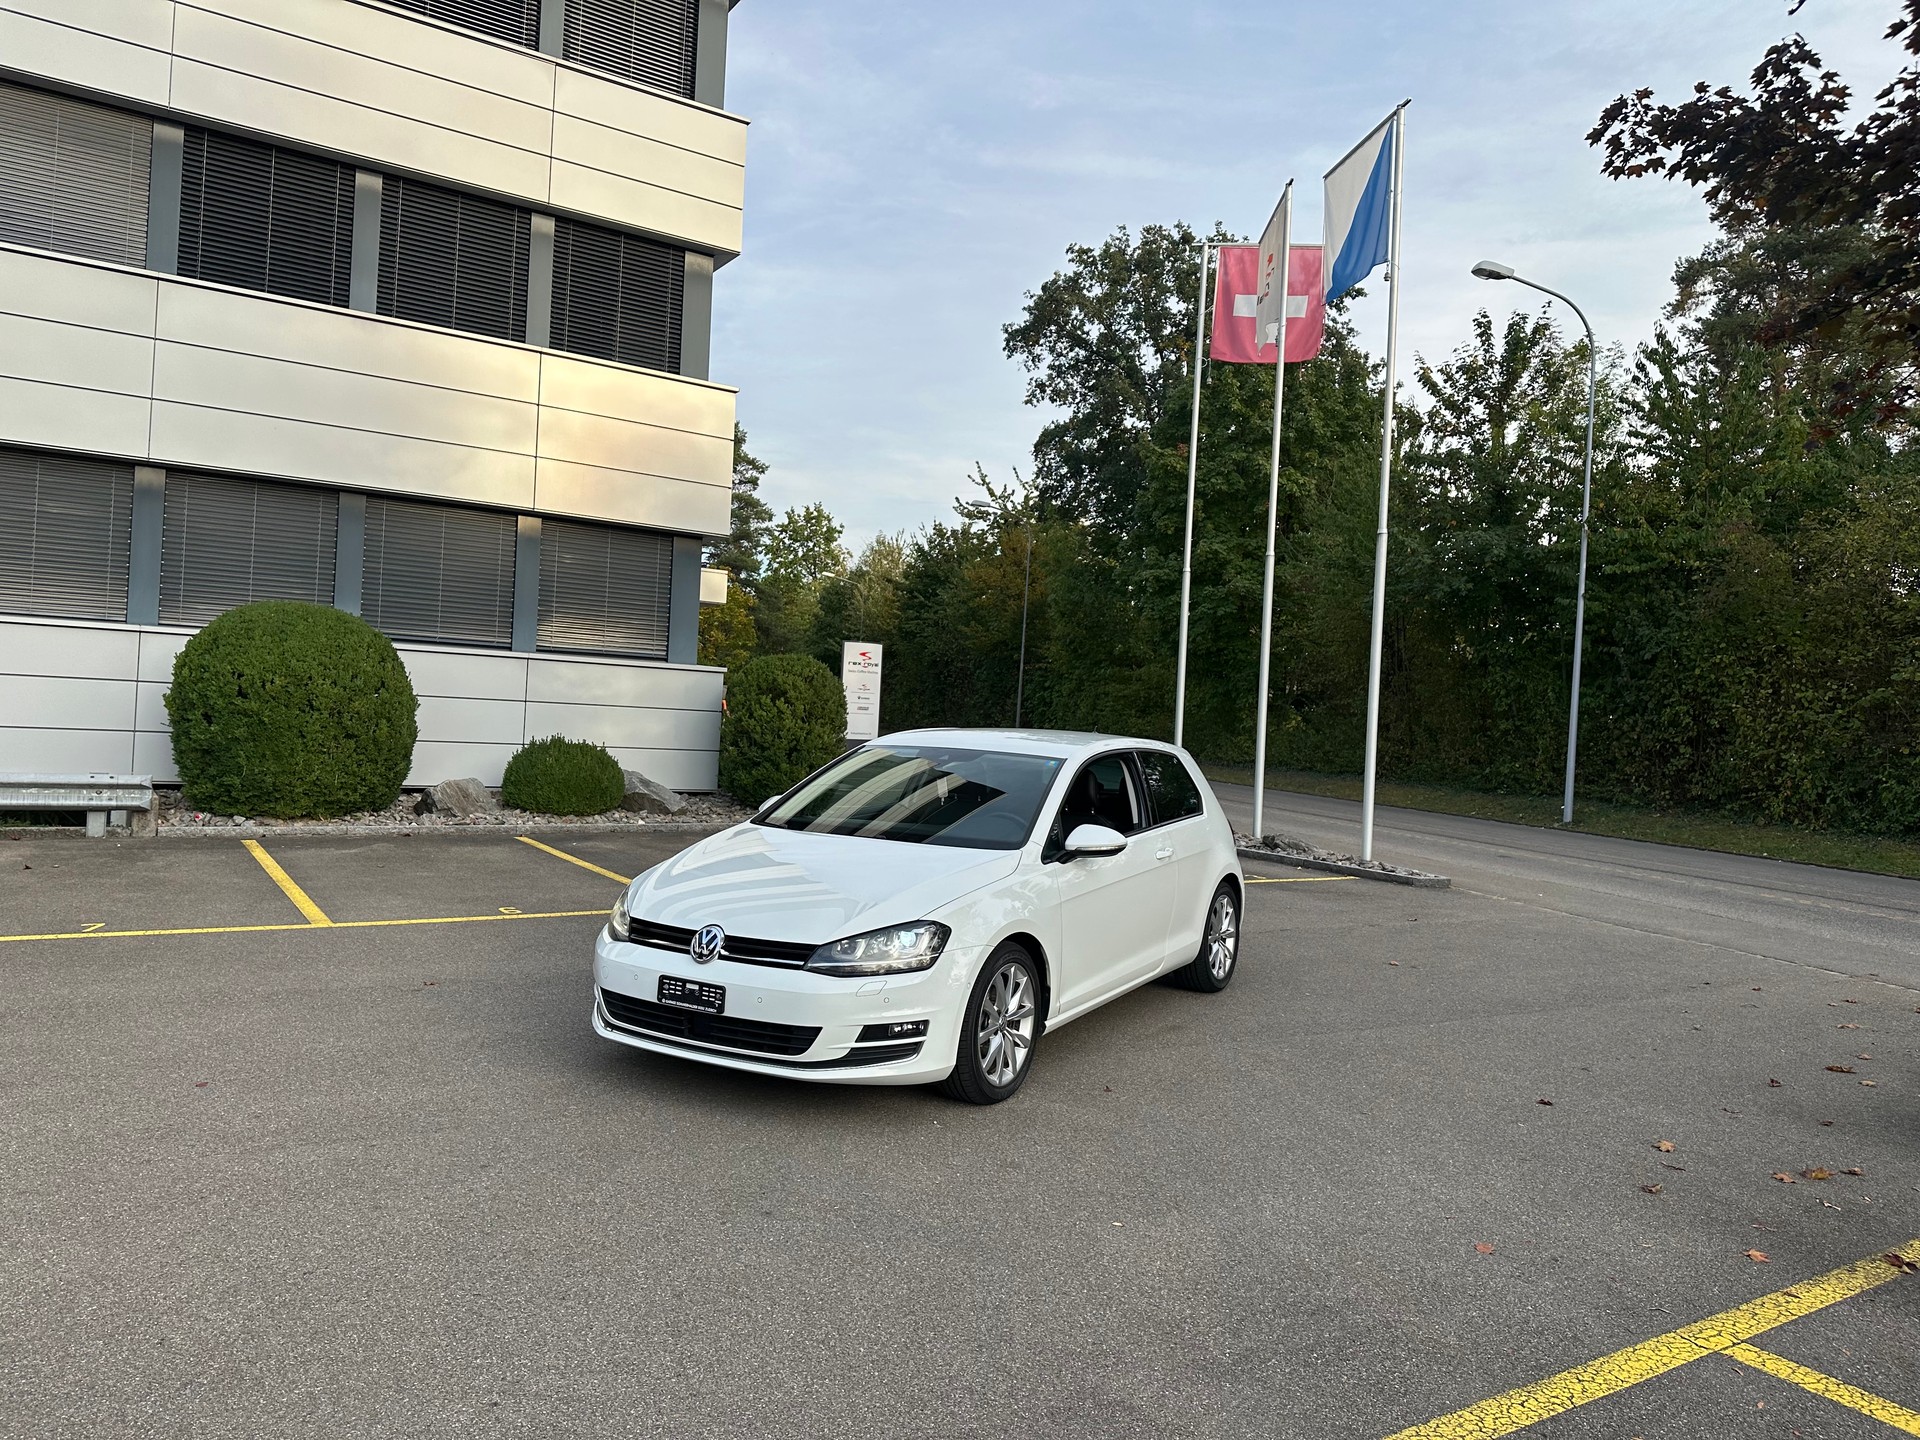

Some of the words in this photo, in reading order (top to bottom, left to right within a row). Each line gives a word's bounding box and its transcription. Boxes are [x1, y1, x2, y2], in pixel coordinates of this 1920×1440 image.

[498, 906, 522, 914] 6
[81, 923, 106, 932] 7
[692, 926, 721, 961] VW
